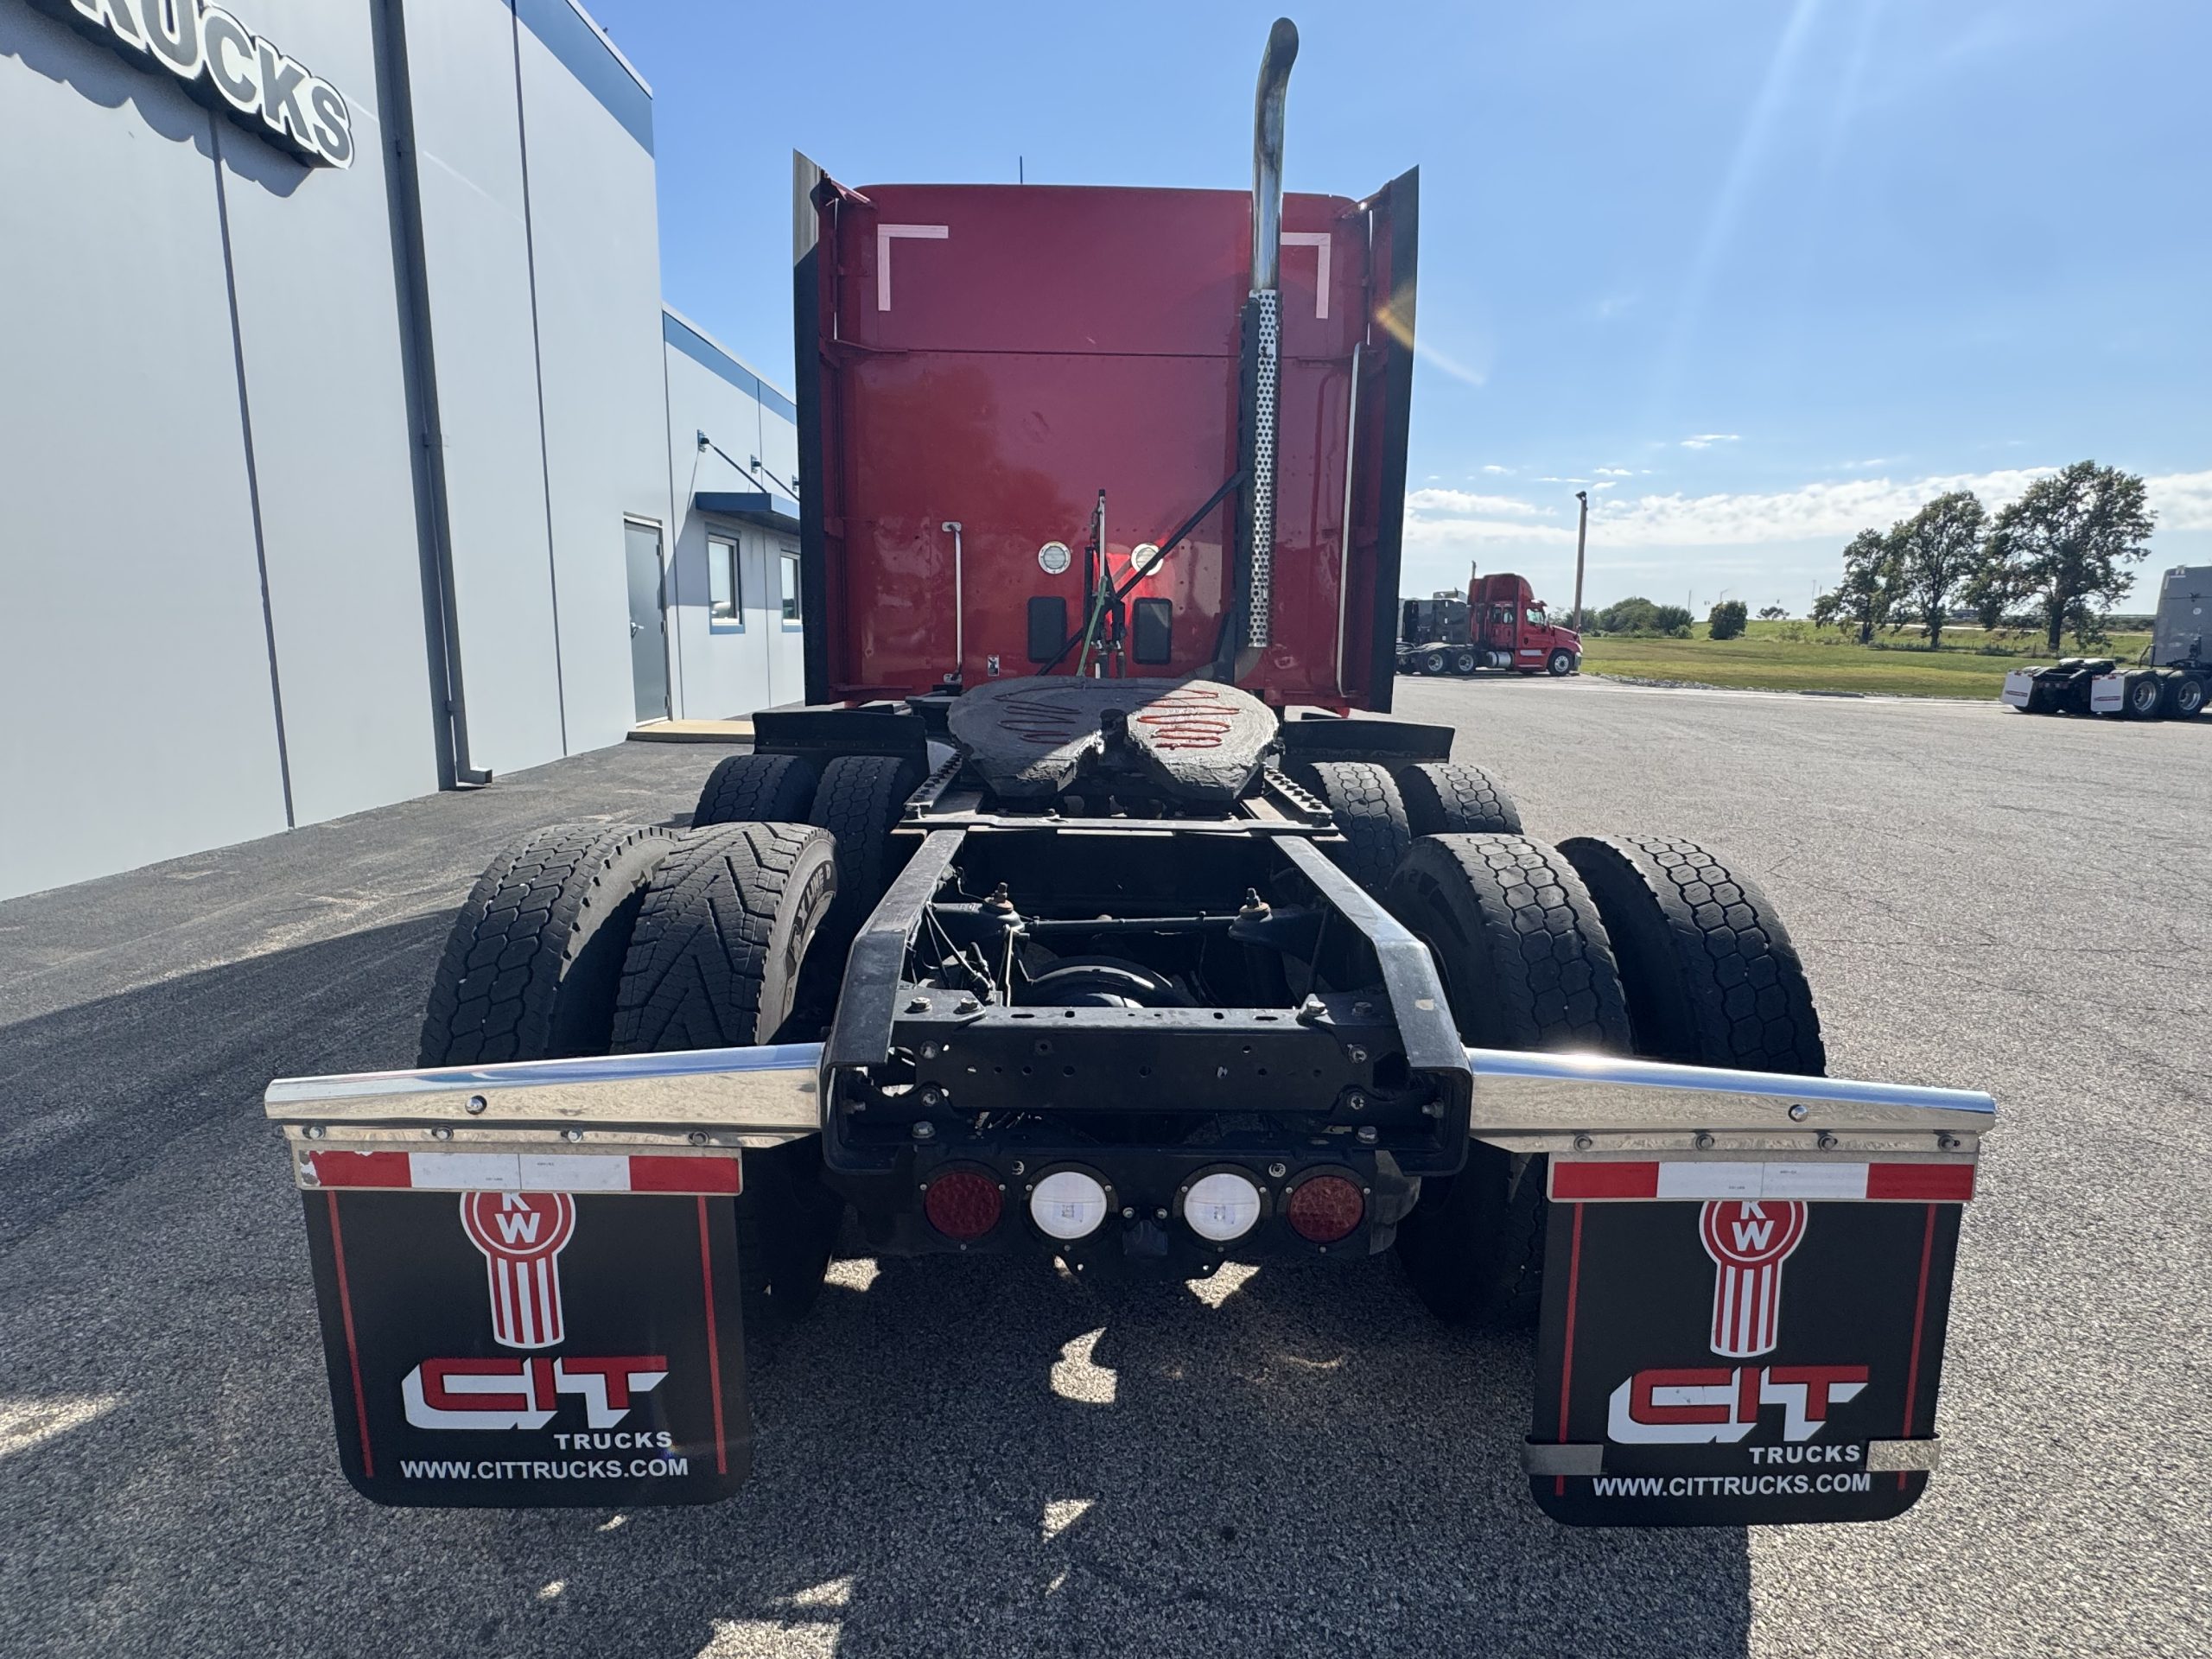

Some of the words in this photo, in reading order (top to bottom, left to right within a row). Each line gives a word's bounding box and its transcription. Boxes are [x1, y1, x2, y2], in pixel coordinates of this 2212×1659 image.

[402, 1356, 669, 1429] CIT
[1608, 1365, 1869, 1444] CIT
[554, 1432, 673, 1450] TRUCKS
[1749, 1446, 1860, 1464] TRUCKS
[400, 1459, 689, 1479] WWW.CITTRUCKS.COM
[1593, 1473, 1871, 1496] WWW.CITTRUCKS.COM
